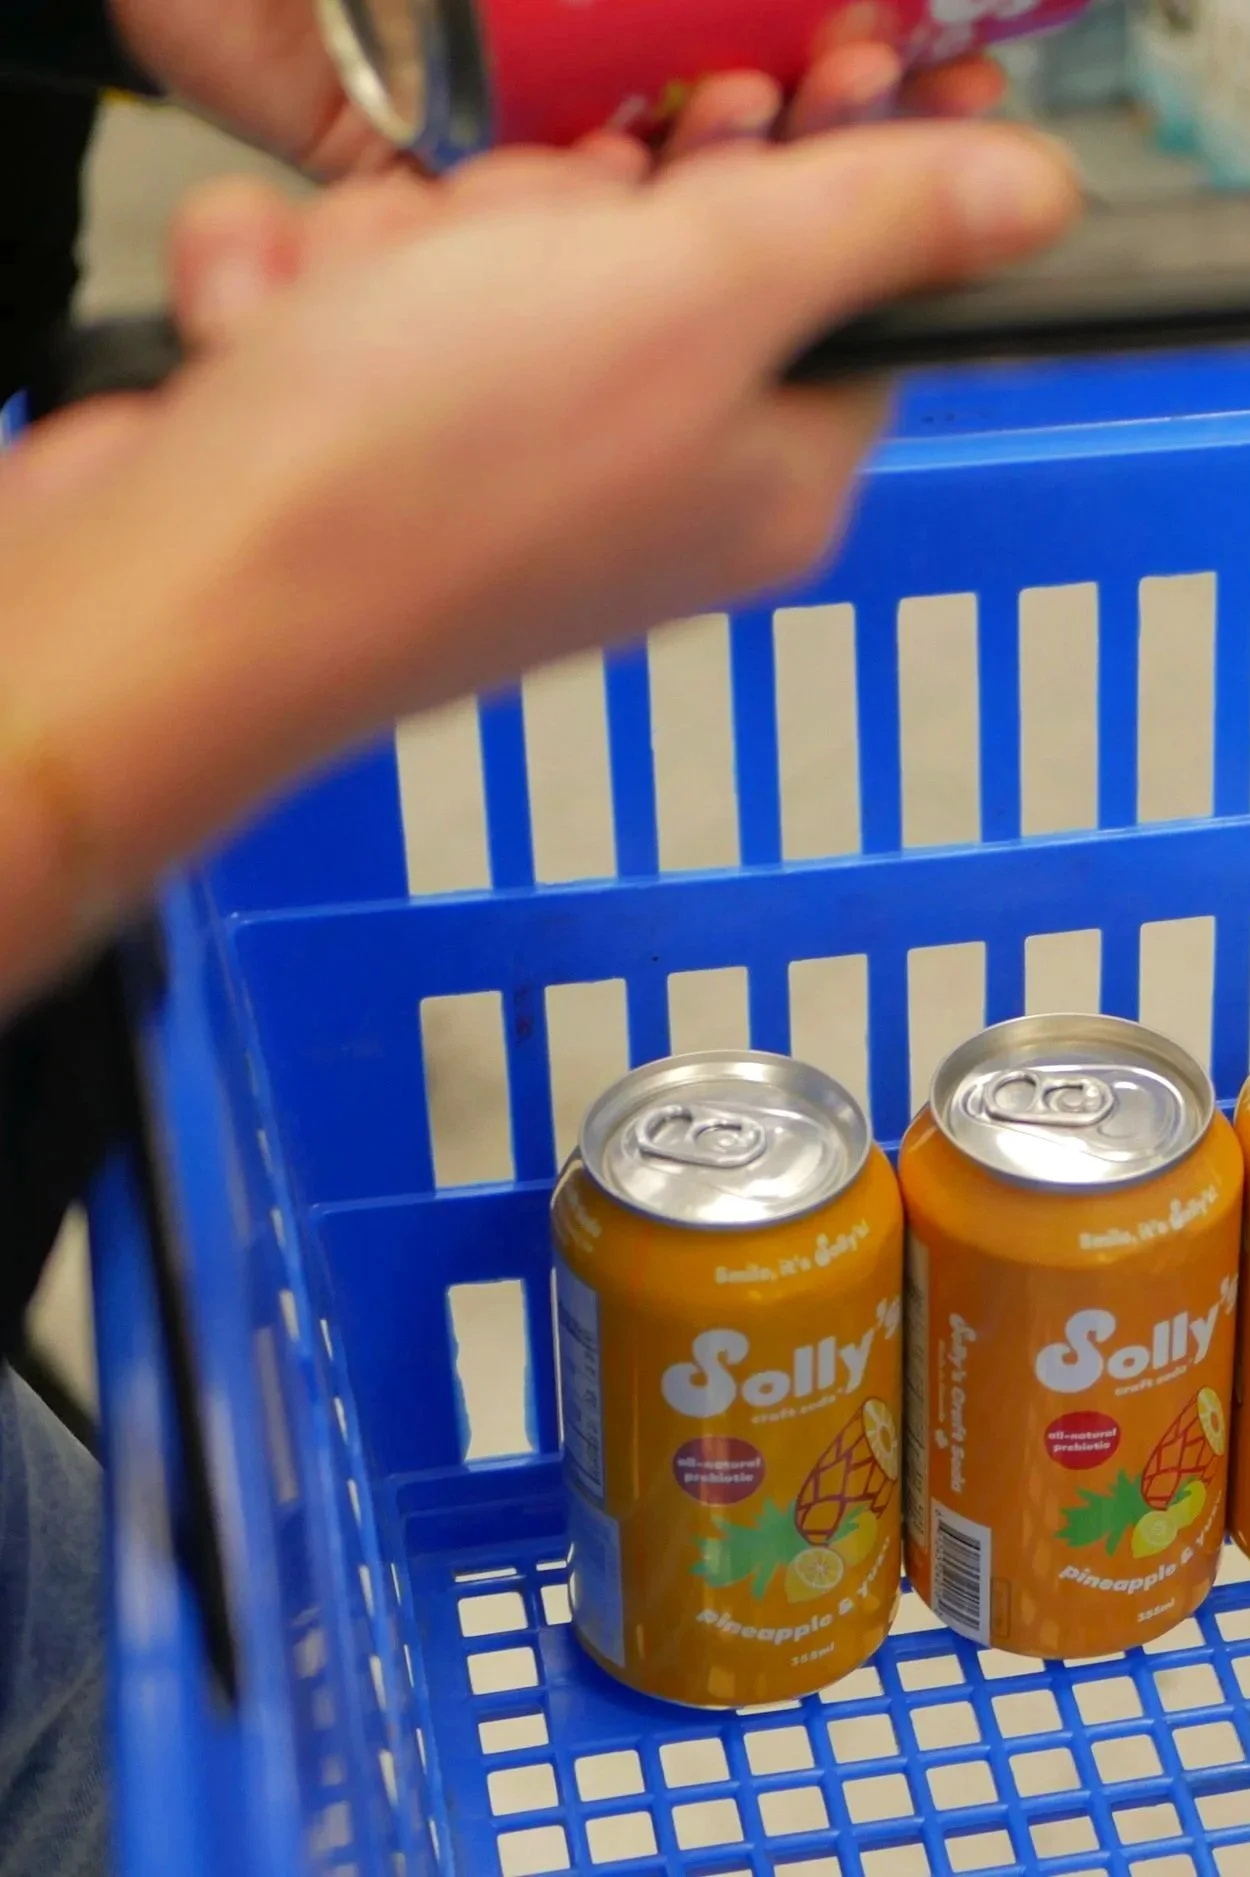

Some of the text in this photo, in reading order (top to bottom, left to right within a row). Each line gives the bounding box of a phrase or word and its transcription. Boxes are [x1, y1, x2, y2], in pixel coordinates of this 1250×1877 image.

[1048, 1428, 1117, 1441] all-natural
[1053, 1441, 1111, 1453] prebiotic
[1059, 1563, 1177, 1596] pineapple
[696, 1608, 833, 1645] pineapple
